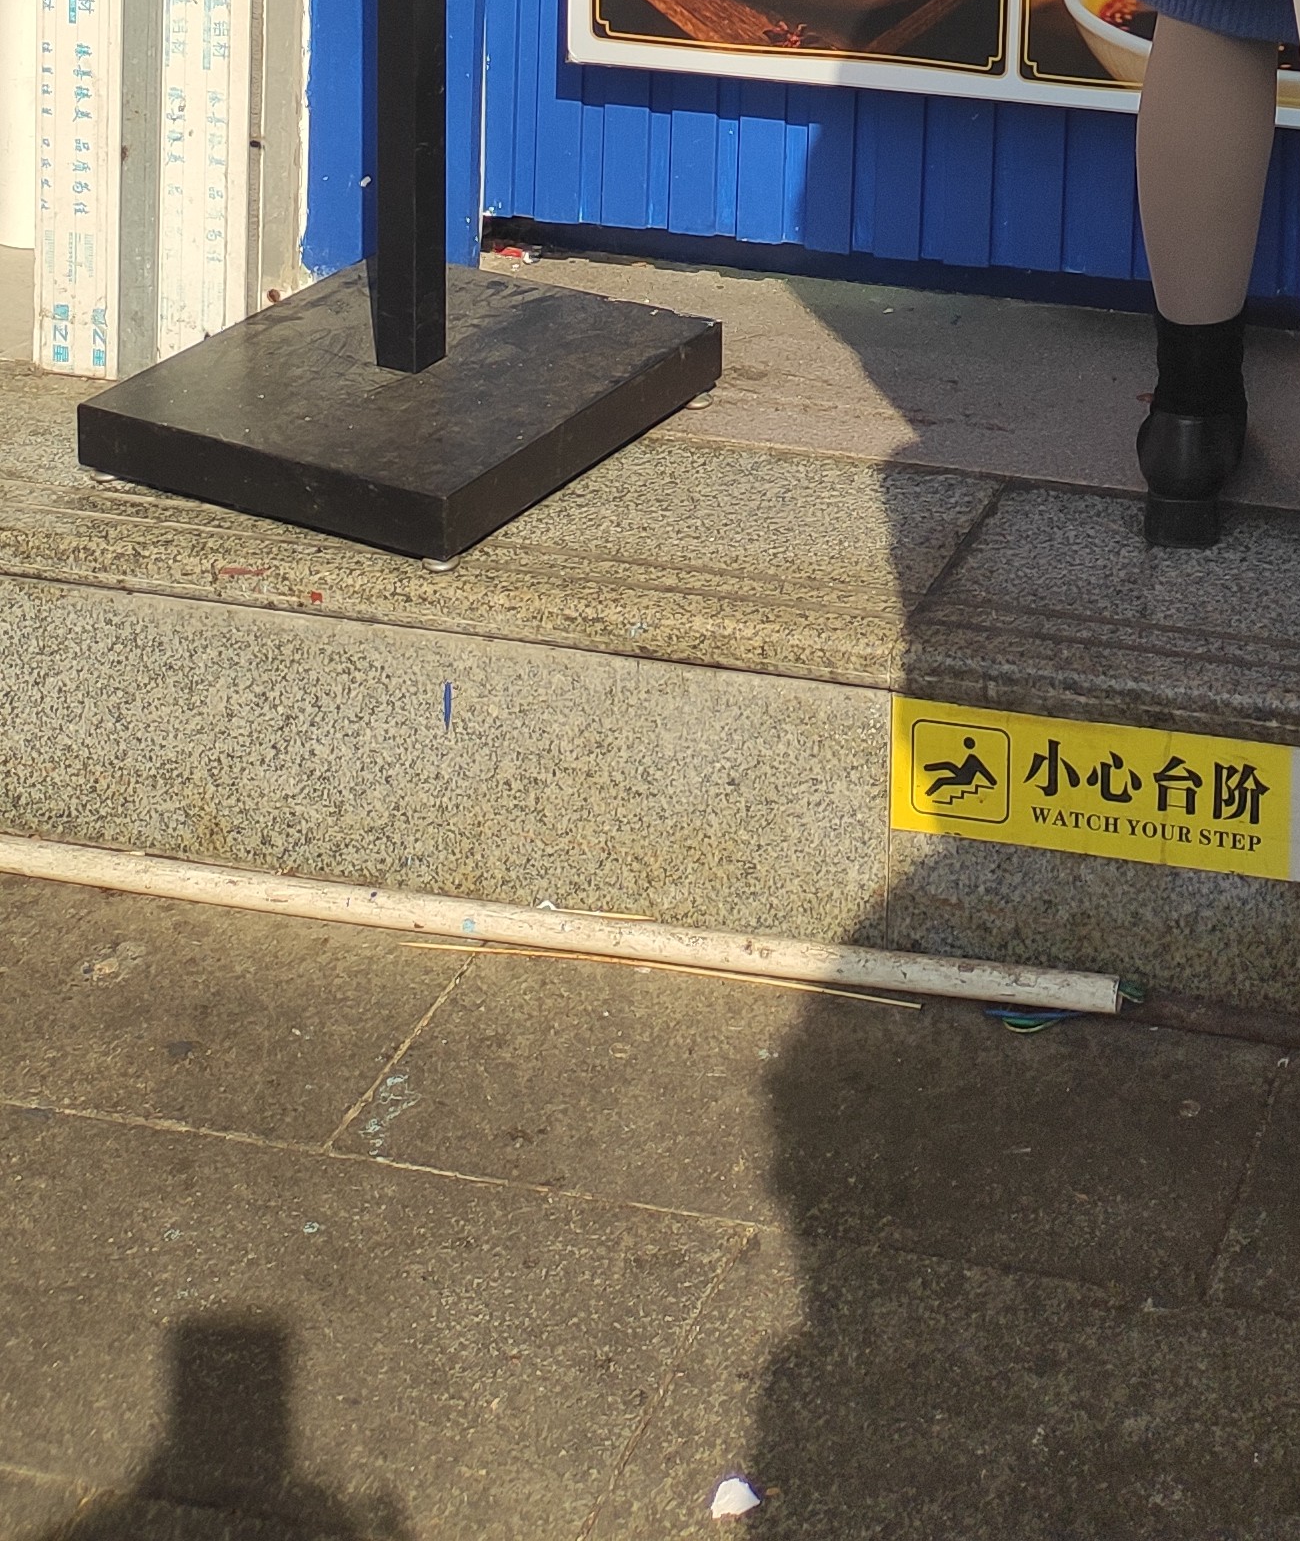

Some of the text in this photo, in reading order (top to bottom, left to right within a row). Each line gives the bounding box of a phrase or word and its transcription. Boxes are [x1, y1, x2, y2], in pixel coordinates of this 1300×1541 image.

[1022, 738, 1272, 826] 小心台阶
[1030, 805, 1263, 853] WATCH YOUR STEP
